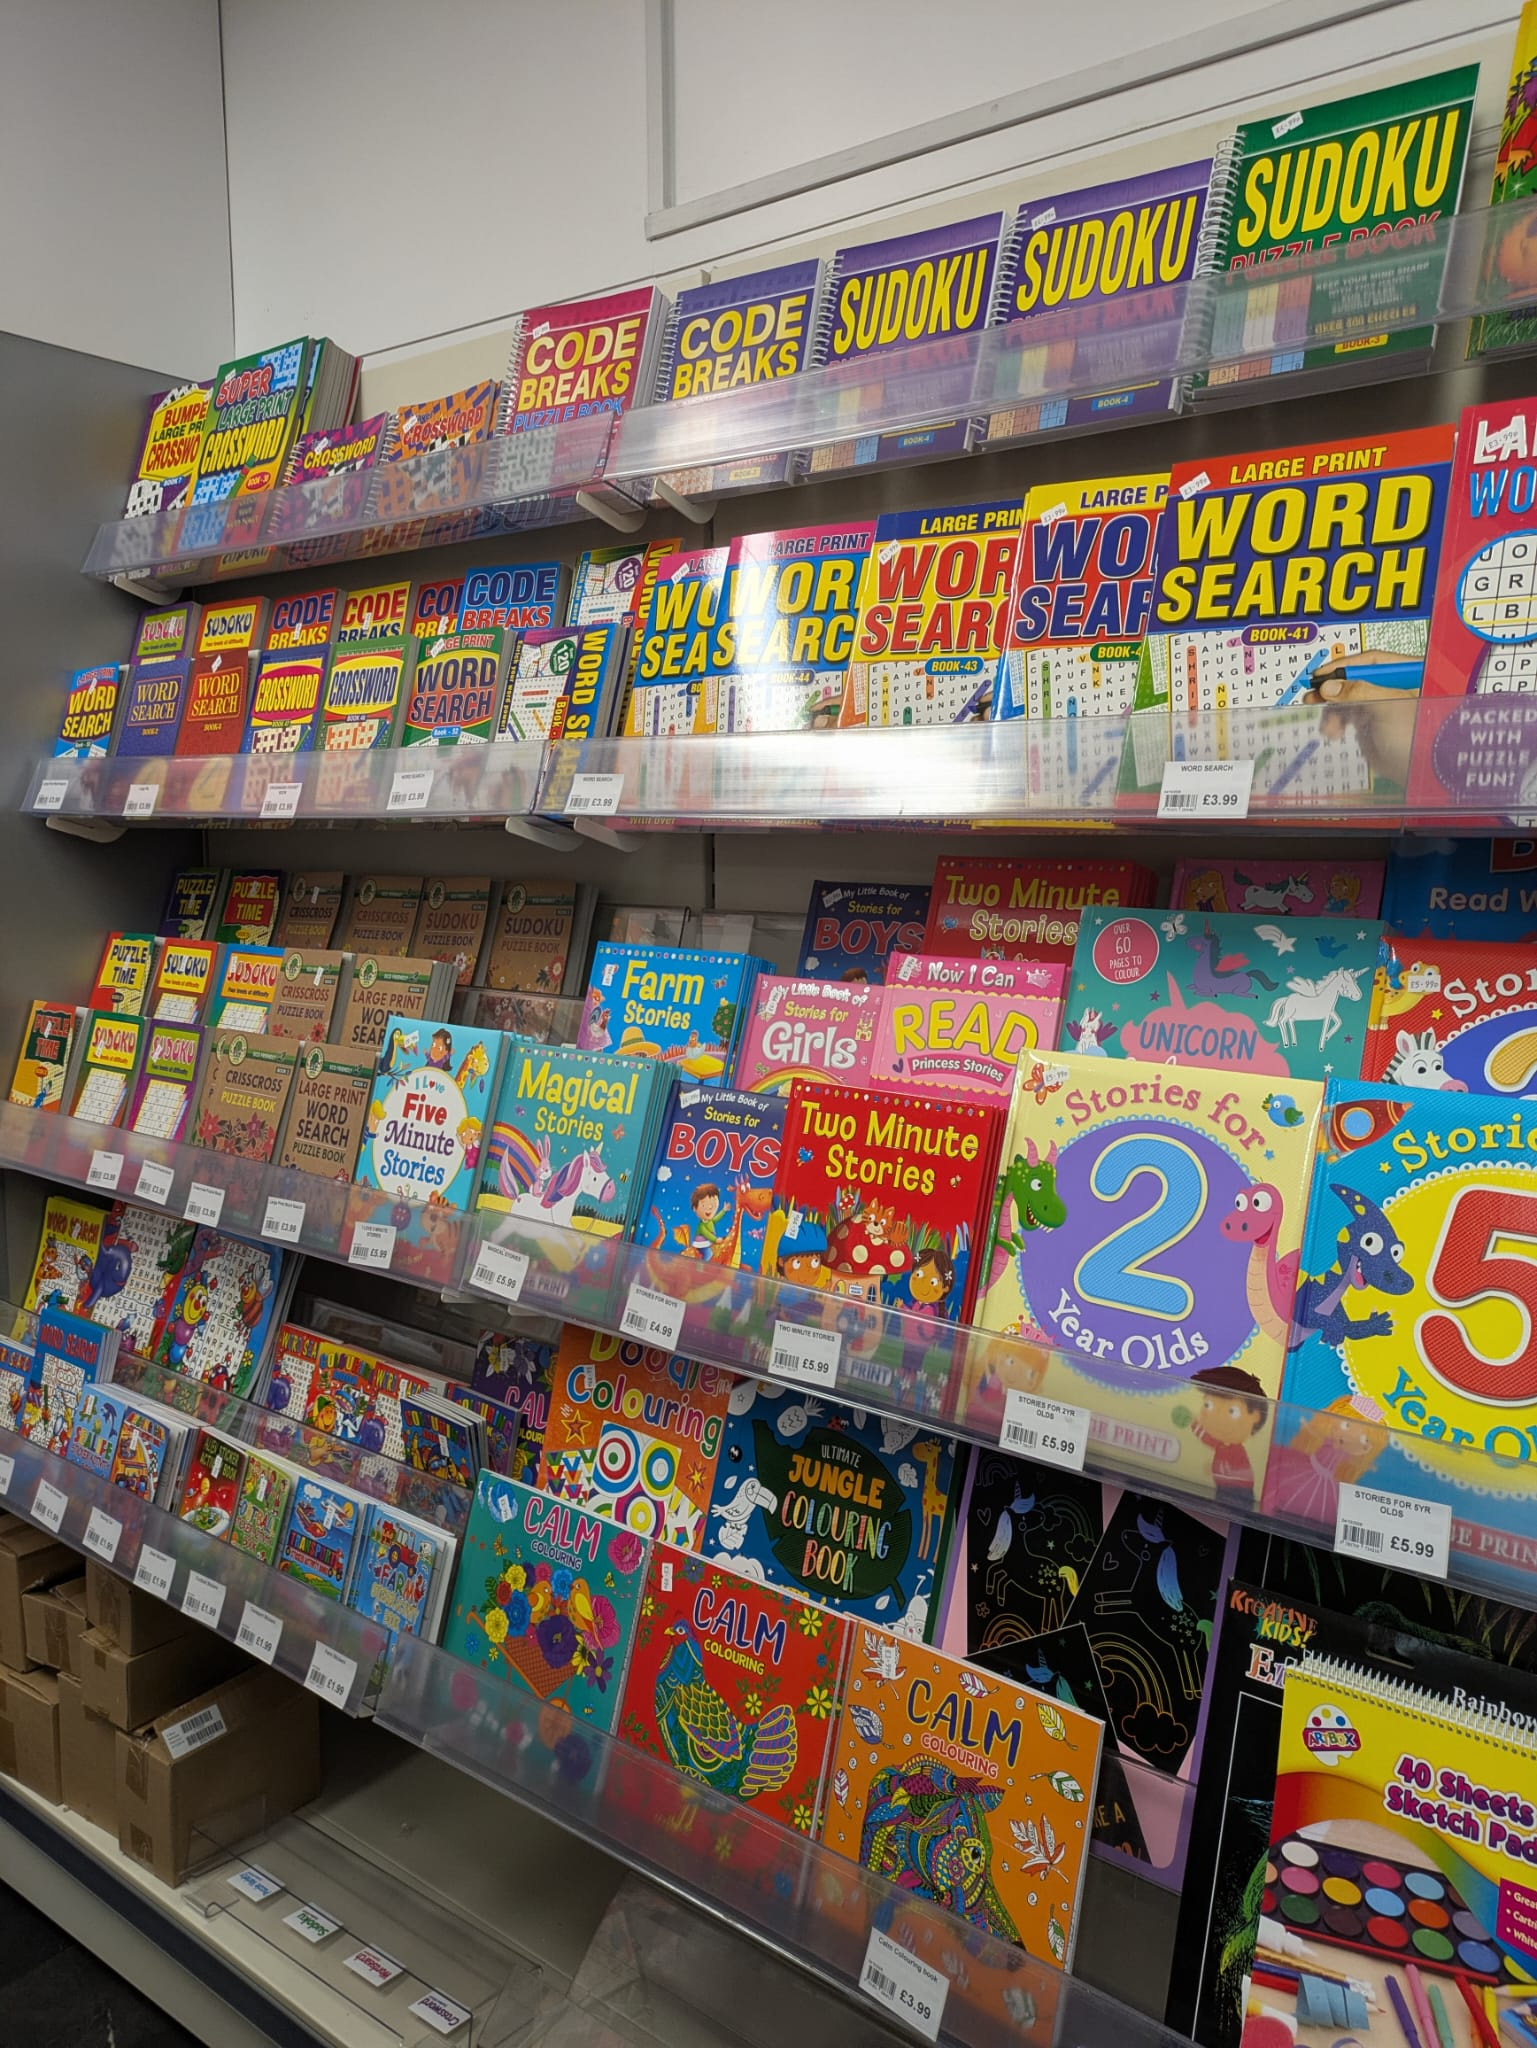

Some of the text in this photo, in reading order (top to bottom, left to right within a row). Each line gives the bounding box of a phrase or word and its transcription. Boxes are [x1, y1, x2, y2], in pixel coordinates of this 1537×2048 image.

[1236, 109, 1460, 248] SUDOKU
[1016, 196, 1198, 312] SUDOKU
[833, 248, 988, 355] SUDOKU
[680, 295, 806, 360] CODE
[526, 318, 641, 375] CODE
[672, 341, 799, 400] BREAKS
[216, 366, 272, 406] SUPER
[517, 361, 631, 412] BREAKS
[218, 389, 294, 430] LARGE PRINT
[153, 425, 185, 442] LARGE
[404, 406, 483, 445] CROSSWORD
[146, 434, 200, 472] CROSSWO
[201, 417, 285, 474] CROSSWORD
[304, 435, 376, 469] CROSSWORD
[1231, 447, 1387, 485] LARGE PRINT
[1080, 487, 1148, 510] LARGE
[920, 514, 977, 535] LARGE
[1176, 475, 1433, 562] WORD
[768, 533, 869, 557] LARGE PRINT
[466, 568, 557, 607] CODE
[1157, 546, 1427, 624] SEARCH
[273, 592, 335, 630] CODE
[345, 589, 407, 625] CODE
[461, 607, 551, 630] BREAKS
[268, 626, 328, 650] BREAKS
[463, 634, 494, 648] PRINT
[1250, 627, 1309, 643] BOOK-41
[416, 656, 496, 693] WORD
[931, 661, 978, 672] BOOK-43
[137, 680, 178, 702] WORD
[198, 672, 240, 698] WORD
[254, 673, 319, 712] CROSSWORD
[329, 666, 397, 708] CROSSWORD
[69, 685, 117, 714] WORD
[131, 703, 175, 722] SEARCH
[191, 696, 238, 717] SEARCH
[410, 690, 492, 723] SEARCH
[63, 711, 113, 738] SEARCH
[1181, 764, 1233, 772] WORD SEARCH
[407, 792, 425, 801] £3.99
[592, 798, 613, 807] £3.99
[1202, 793, 1238, 807] £3.99
[946, 875, 1120, 911] Two Minute
[1429, 887, 1509, 912] Read
[237, 904, 262, 921] TIME
[426, 912, 480, 930] SUDOKU
[848, 901, 902, 916] Stories for
[505, 917, 565, 936] SUDOKU
[1114, 923, 1131, 934] OVER
[110, 944, 148, 964] PUZZLE
[1116, 937, 1131, 954] 60
[927, 961, 964, 983] Now
[981, 967, 1015, 987] Can
[1109, 955, 1142, 968] PAGES TO
[1115, 967, 1140, 980] COLOUR
[112, 966, 136, 984] TIME
[621, 960, 705, 1005] Farm
[281, 986, 329, 1001] CRISSCROSS
[353, 990, 423, 1010] LARGE PRINT
[277, 1005, 324, 1020] PUZZLE BOOK
[624, 1000, 691, 1030] Stories
[784, 1001, 849, 1022] Stories for
[762, 1020, 858, 1069] Girls
[893, 1000, 1038, 1064] READ
[1139, 1021, 1257, 1060] UNICORN
[226, 1070, 283, 1092] CRISSCROSS
[912, 1058, 1005, 1082] Princess Stories
[298, 1080, 366, 1106] LARGE PRINT
[517, 1059, 639, 1116] Magical
[221, 1092, 276, 1112] PUZZLE BOOK
[307, 1100, 348, 1125] WORD
[402, 1093, 447, 1126] Five
[1065, 1074, 1266, 1151] Stories for
[535, 1107, 604, 1141] Stories
[704, 1106, 760, 1128] Stories for
[296, 1119, 350, 1147] SEARCH
[384, 1120, 455, 1156] Minute
[801, 1101, 979, 1162] Two Minute
[293, 1142, 345, 1164] PUZZLE BOOK
[380, 1149, 445, 1186] Stories
[825, 1144, 935, 1194] Stories
[201, 1207, 216, 1218] £3.99
[281, 1222, 297, 1233] £3.99
[1073, 1133, 1208, 1322] 2
[370, 1248, 387, 1258] £5.99
[496, 1275, 517, 1289] £5.99
[636, 1288, 678, 1308] STORIES FOR BOYS
[649, 1321, 673, 1337] £4.99
[779, 1324, 835, 1342] TWO MINUTE STORIES
[1048, 1288, 1210, 1370] Year Olds
[802, 1358, 829, 1374] £5.99
[566, 1364, 724, 1459] Colouring
[1018, 1395, 1075, 1417] STORIES FOR 2YR
[1037, 1410, 1054, 1420] OLDS
[821, 1443, 862, 1466] ULTIMATE
[1042, 1434, 1075, 1454] £5.99
[788, 1453, 886, 1511] JUNGLE
[1354, 1490, 1431, 1514] STORIES FOR 5YR
[1380, 1506, 1404, 1518] OLDS
[523, 1495, 602, 1562] CALM
[781, 1490, 892, 1559] COLOURING
[531, 1540, 582, 1570] COLOURING
[1390, 1536, 1434, 1558] £5.99
[802, 1538, 860, 1593] BOOK
[152, 1575, 166, 1589] £1.99
[201, 1602, 217, 1617] £1.99
[693, 1588, 787, 1666] CALM
[256, 1637, 272, 1652] £1.99
[704, 1640, 765, 1676] COLOURING
[327, 1678, 344, 1696] £1.99
[905, 1677, 1023, 1769] CALM
[1309, 1731, 1357, 1748] ARTBOX
[921, 1733, 999, 1779] COLOURING
[1398, 1756, 1535, 1827] 40 Sheets
[1386, 1784, 1481, 1842] Sketch
[296, 1913, 329, 1936] Sudoku
[879, 1937, 893, 1951] Calm
[894, 1948, 922, 1973] Colouring
[418, 1998, 460, 2026] Crossword
[900, 1990, 931, 2020] £3.99
